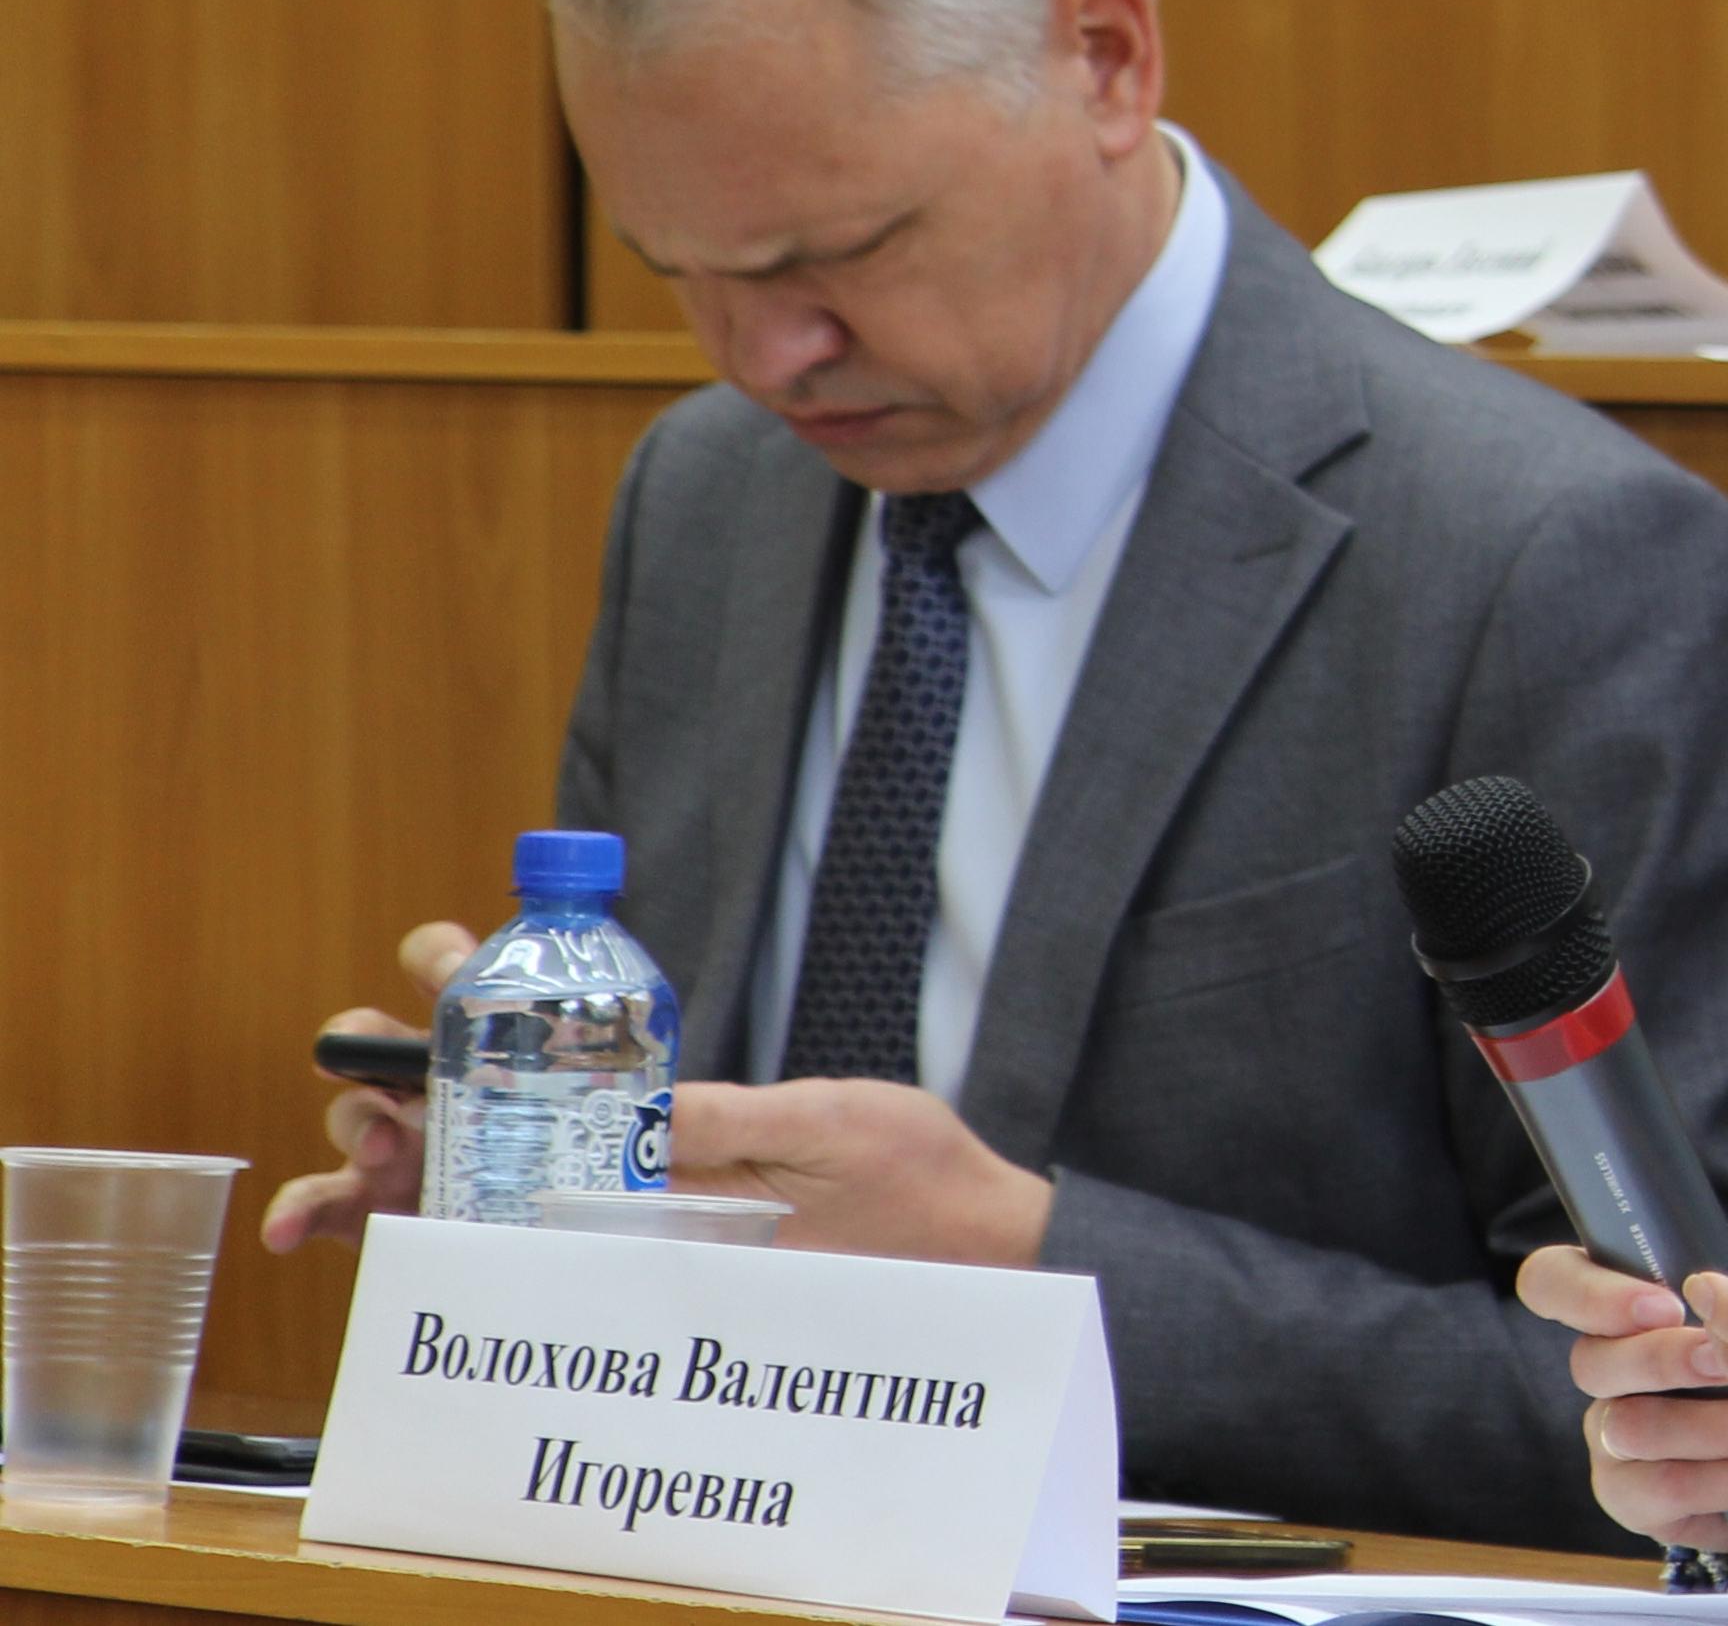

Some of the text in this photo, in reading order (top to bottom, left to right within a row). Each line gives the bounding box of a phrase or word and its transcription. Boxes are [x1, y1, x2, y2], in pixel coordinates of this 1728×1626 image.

[1629, 1222, 1666, 1285] NNHEISER
[399, 1311, 987, 1430] Волохова Валентина
[520, 1436, 795, 1532] Игоревна
